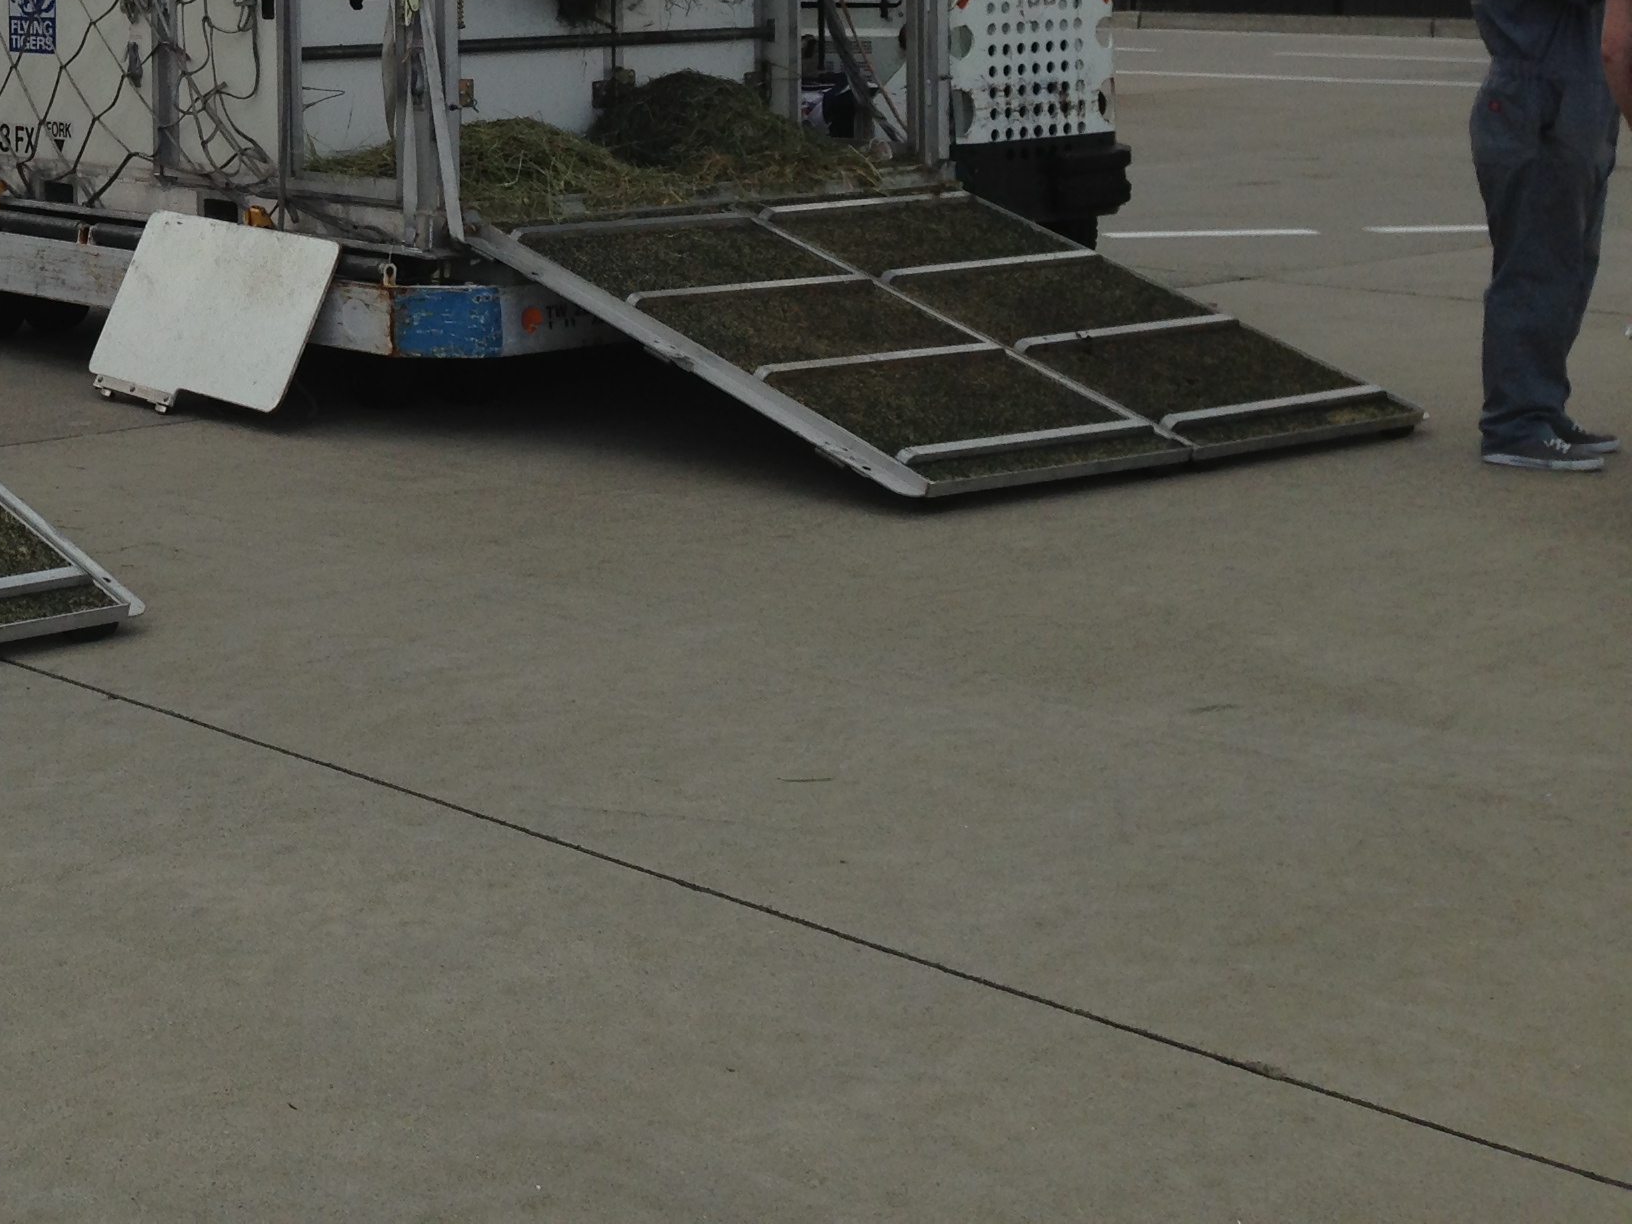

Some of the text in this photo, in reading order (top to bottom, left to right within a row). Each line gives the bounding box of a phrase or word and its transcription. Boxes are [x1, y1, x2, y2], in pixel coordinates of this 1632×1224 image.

[11, 19, 54, 35] FLYING
[11, 34, 55, 51] TIGERS
[46, 121, 72, 139] FORK
